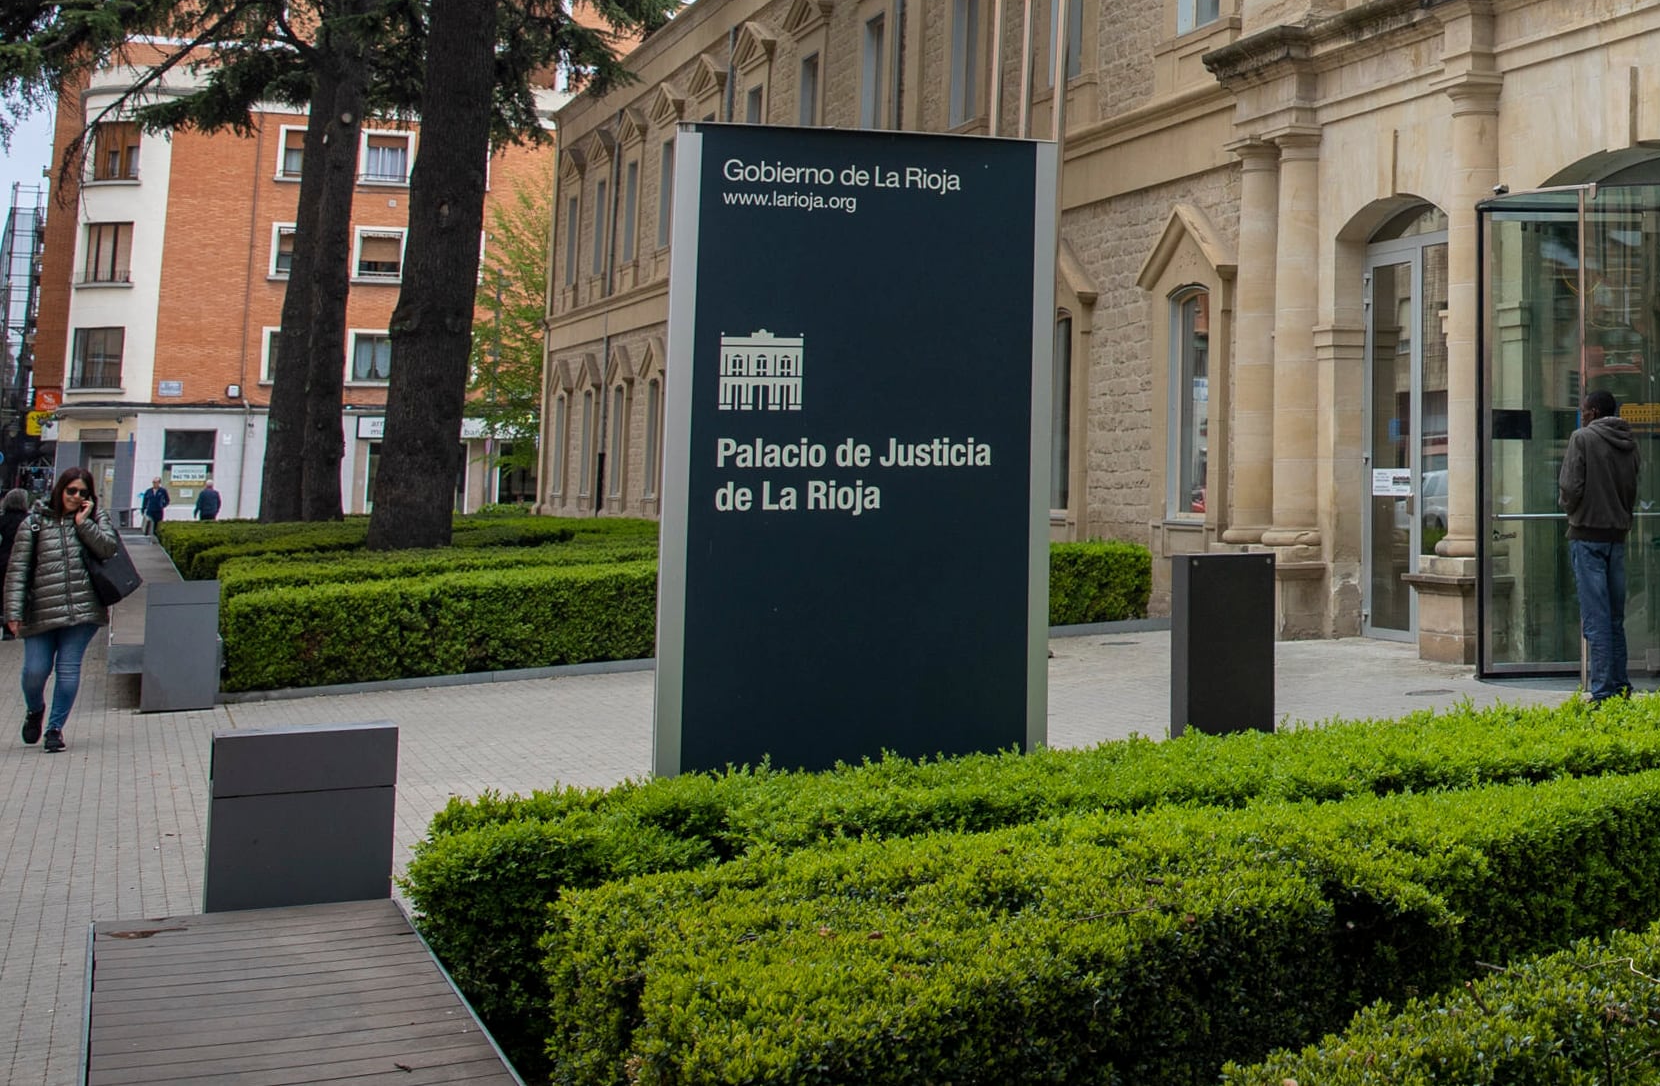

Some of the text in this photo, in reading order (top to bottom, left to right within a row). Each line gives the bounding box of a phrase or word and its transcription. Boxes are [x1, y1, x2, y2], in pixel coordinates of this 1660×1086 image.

[722, 158, 962, 196] Gobierno de La Rioja
[722, 189, 858, 214] www.larioja.org
[716, 437, 992, 469] Palacio de Justicia
[715, 479, 881, 516] de La Rioja
